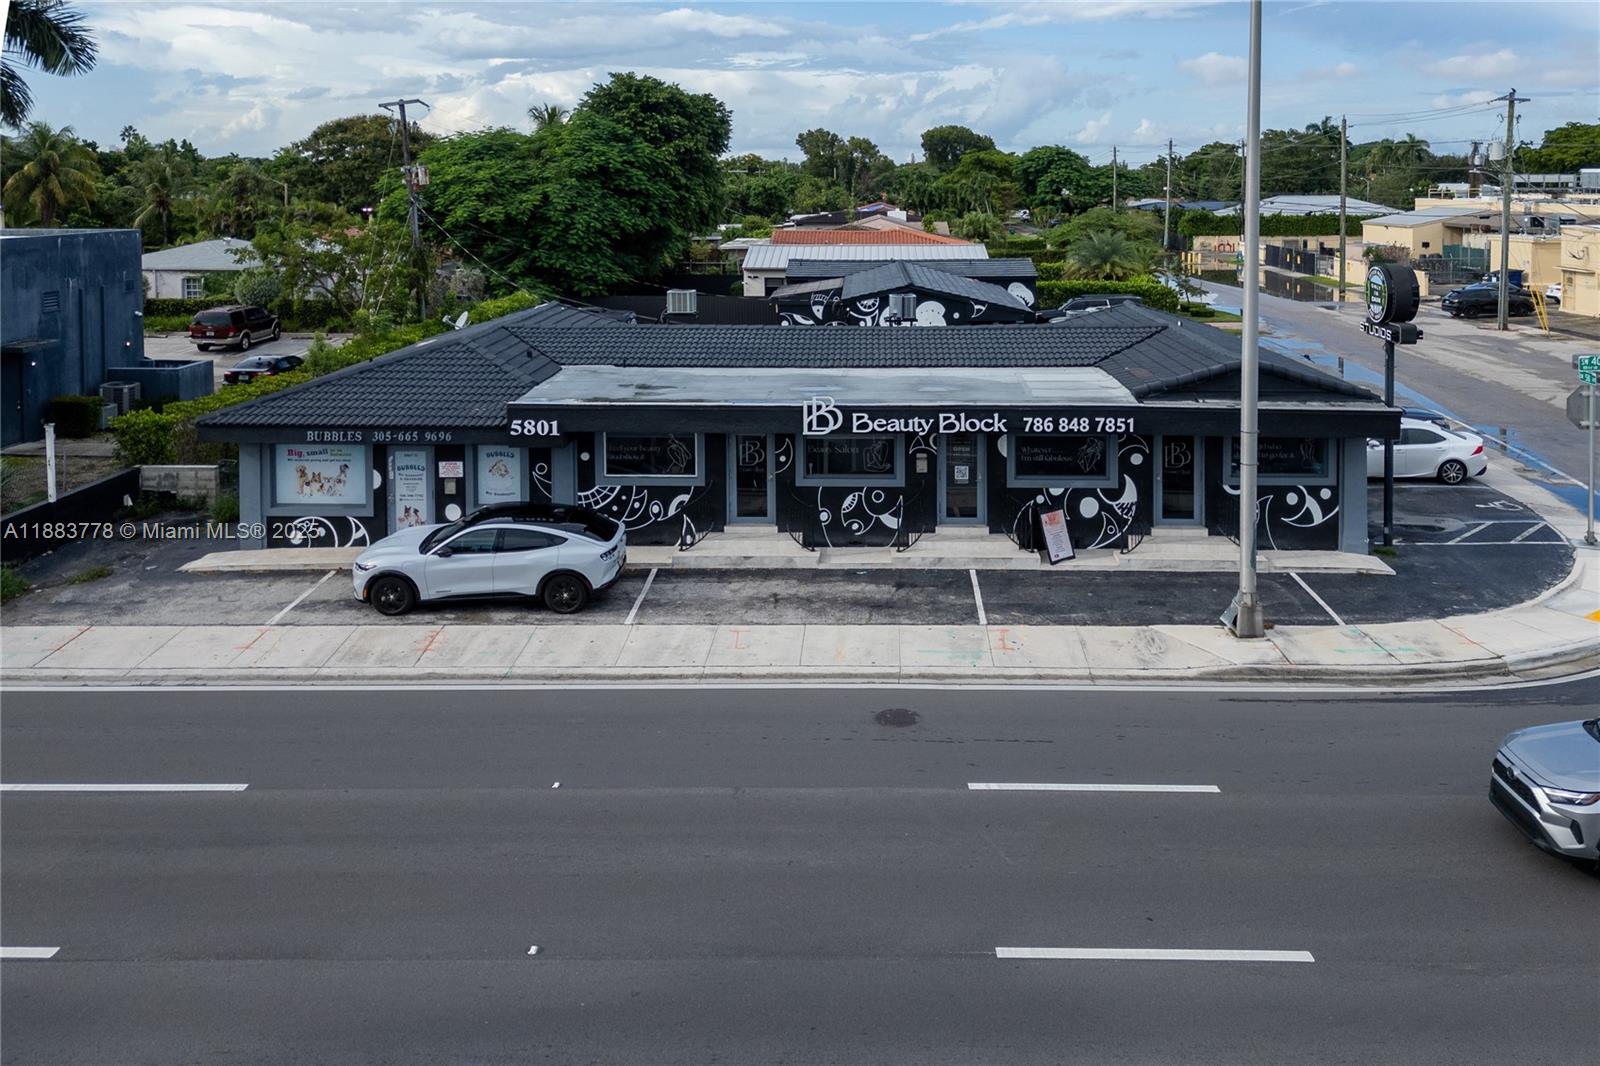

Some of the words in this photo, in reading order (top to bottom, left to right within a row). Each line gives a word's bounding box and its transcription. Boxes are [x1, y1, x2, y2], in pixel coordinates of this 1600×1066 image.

[510, 420, 560, 436] 5801
[852, 412, 934, 435] Beauty
[938, 412, 1008, 434] Block
[1023, 417, 1053, 433] 786
[1058, 417, 1090, 433] 848
[1095, 417, 1134, 433] 7851
[306, 431, 363, 442] BUBBLES
[372, 431, 419, 442] 305-665
[424, 431, 452, 442] 9696
[306, 448, 329, 456] small
